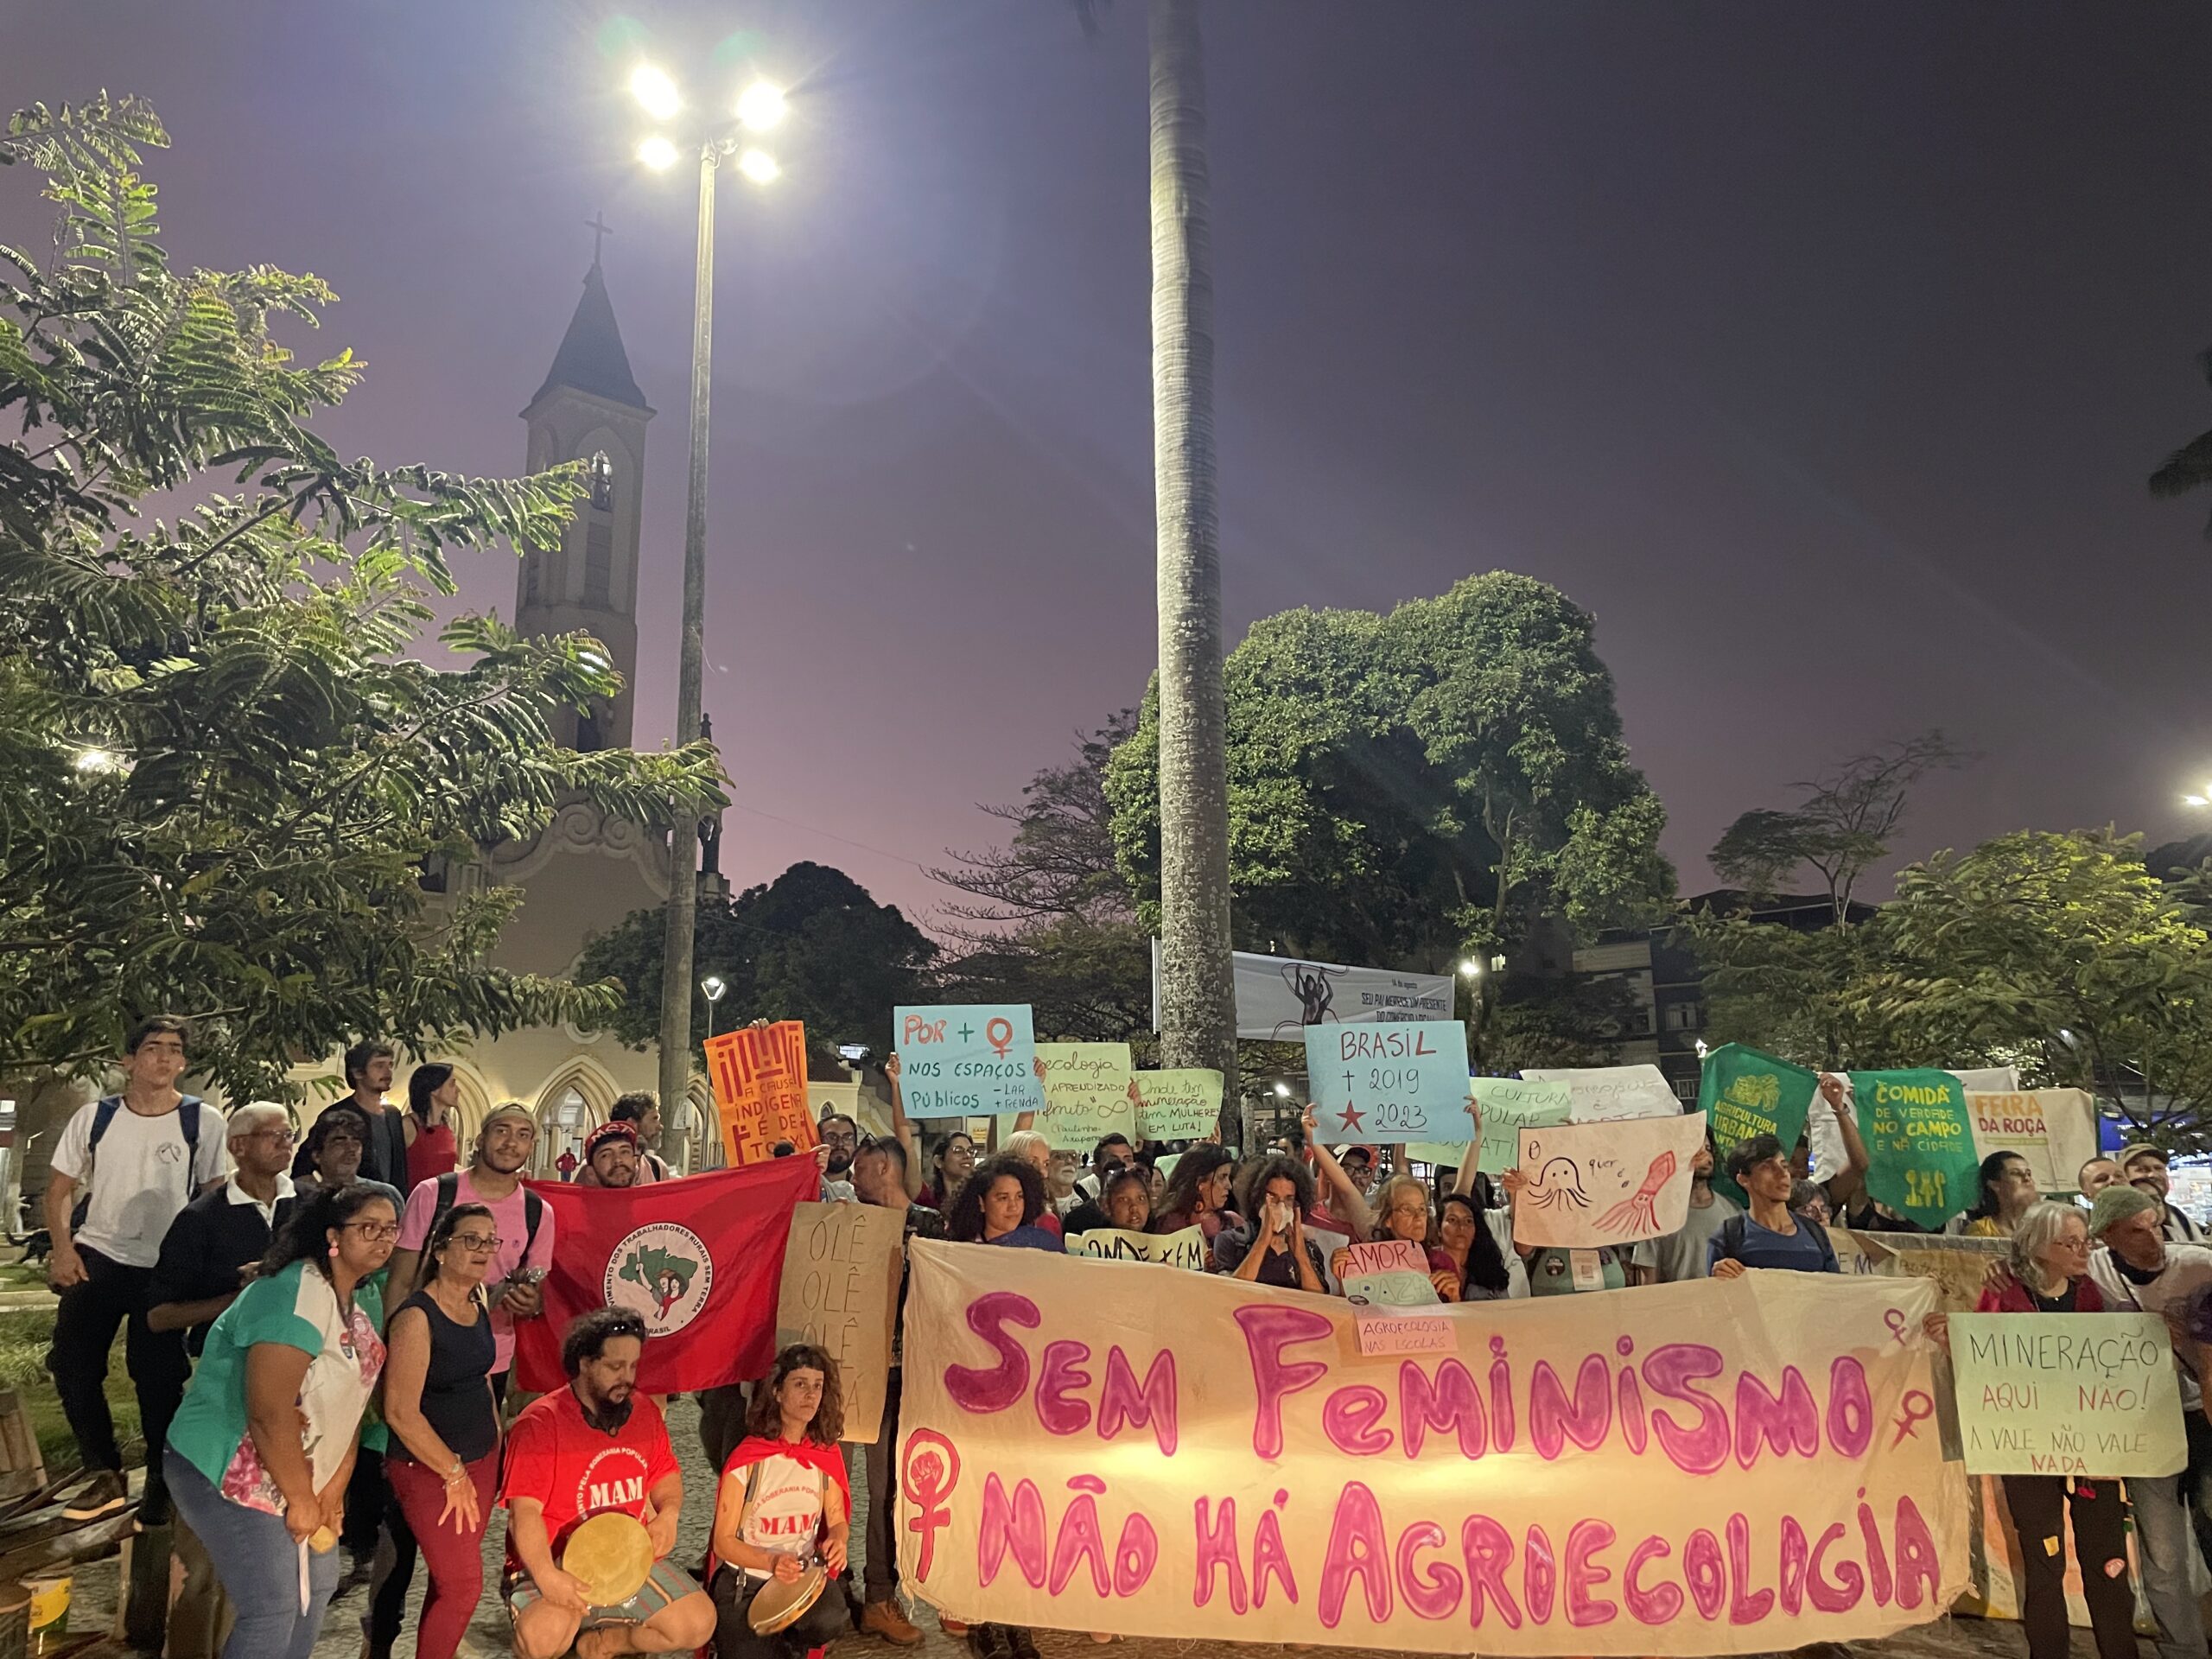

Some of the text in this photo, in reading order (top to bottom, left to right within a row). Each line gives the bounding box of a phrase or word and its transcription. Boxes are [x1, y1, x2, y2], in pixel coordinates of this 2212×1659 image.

[904, 1014, 947, 1046] POR
[909, 1062, 1027, 1080] NOS ESPAÇOS
[1043, 1051, 1119, 1079] ecologia
[760, 1077, 795, 1093] CAUSA
[1005, 1083, 1026, 1095] LAR
[1370, 1068, 1420, 1094] 2019
[1875, 1080, 1950, 1105] COMIDA
[1491, 1085, 1571, 1105] CULTURA
[1975, 1094, 2044, 1116] FEIRA
[758, 1114, 797, 1136] É DE
[1375, 1103, 1427, 1129] 2023
[1714, 1099, 1777, 1135] AGRICULTURA
[1875, 1107, 1955, 1120] DE VERDADE
[1148, 1123, 1166, 1133] EM
[1713, 1114, 1764, 1141] URBAN
[1873, 1121, 1961, 1138] NO CAMPO
[1978, 1117, 2047, 1137] DA ROÇA
[749, 1134, 804, 1159] TOXS
[1877, 1140, 1885, 1150] E
[622, 1224, 690, 1246] TRABALHADORES
[809, 1214, 867, 1264] OLÊ
[613, 1247, 624, 1264] DOS
[689, 1235, 709, 1263] RURAIS
[1343, 1243, 1416, 1279] AMOR
[691, 1286, 709, 1313] TERRA
[802, 1265, 861, 1313] OLÊ
[1363, 1320, 1450, 1336] AGROECOLOGIA
[1970, 1326, 2158, 1378] MINERAÇÃO
[944, 1292, 1178, 1457] SEM
[2079, 1375, 2151, 1412] NÃO!
[1992, 1428, 2036, 1451] VALE
[2051, 1424, 2085, 1452] NÃO
[2097, 1433, 2149, 1453] VALE
[2031, 1454, 2088, 1474] NADA
[589, 1476, 644, 1510] MAM
[761, 1485, 800, 1503] SOBERANIA
[760, 1512, 817, 1535] MAM
[978, 1471, 1158, 1598] NÃO
[1193, 1487, 1300, 1616] HÁ
